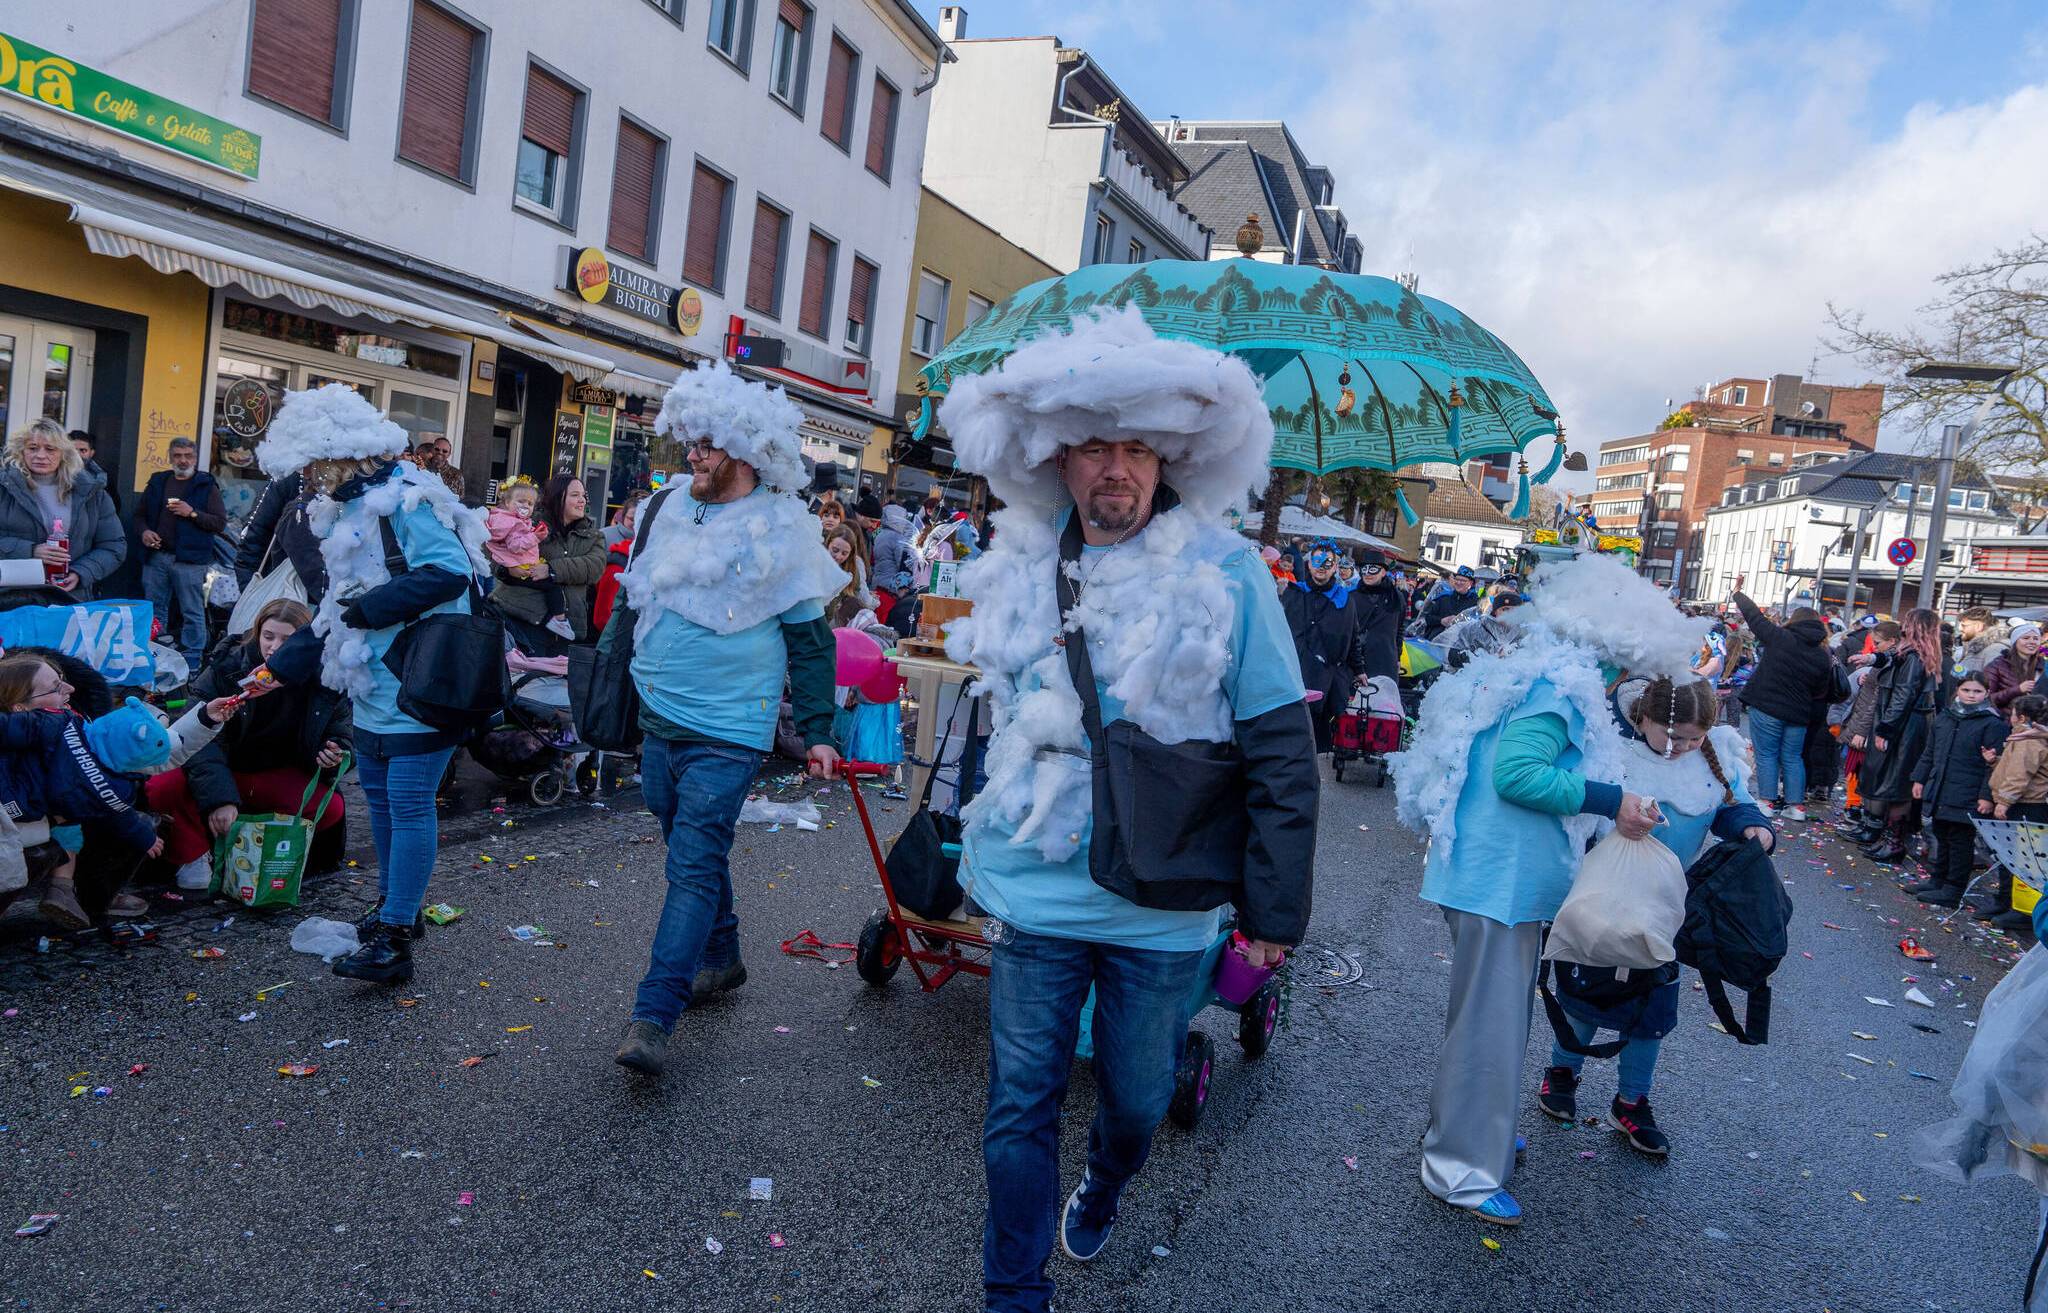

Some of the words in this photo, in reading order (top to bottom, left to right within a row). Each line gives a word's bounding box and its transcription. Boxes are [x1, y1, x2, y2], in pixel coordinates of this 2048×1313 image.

[146, 114, 156, 126] e
[164, 115, 211, 144] Gelato
[616, 289, 660, 318] BISTRO
